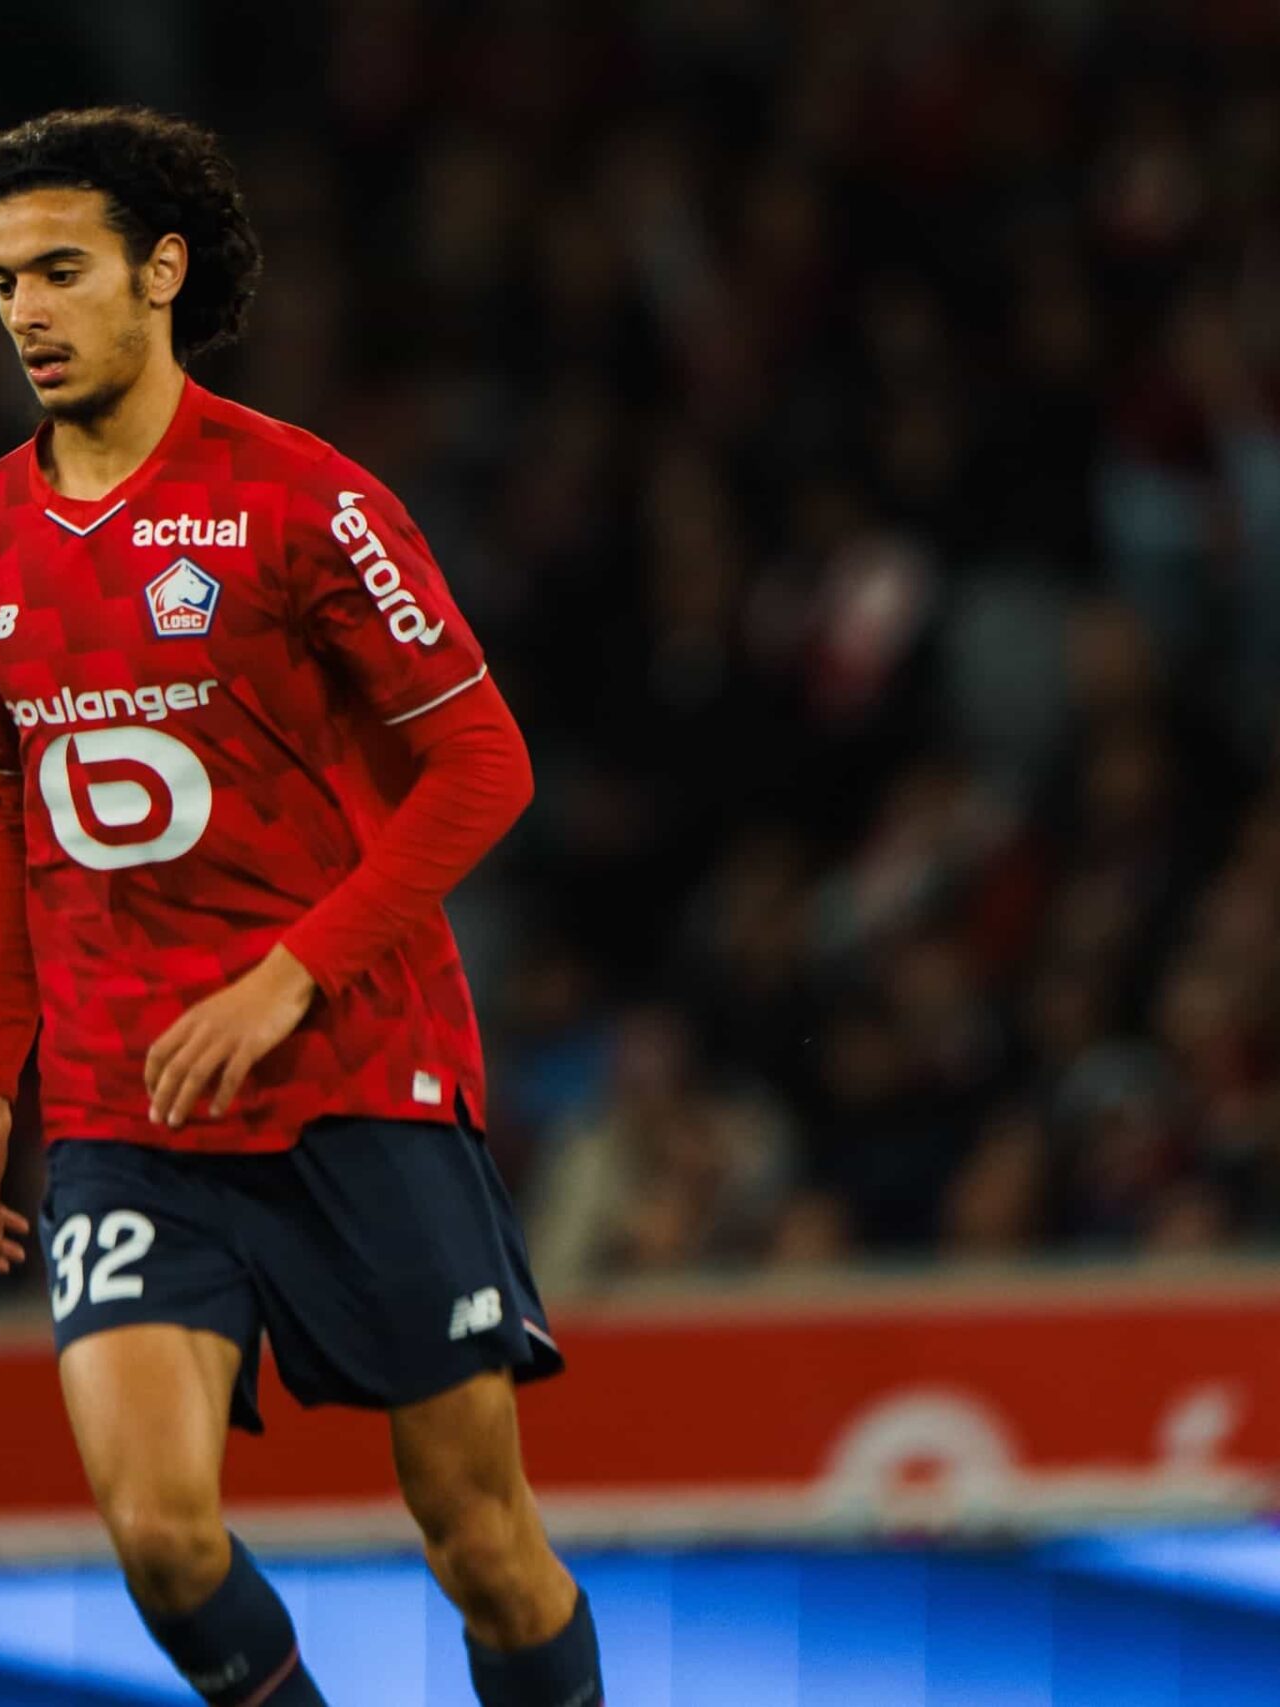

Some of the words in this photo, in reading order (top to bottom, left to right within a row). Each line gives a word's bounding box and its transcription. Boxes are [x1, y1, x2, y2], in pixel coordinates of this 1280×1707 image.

[132, 511, 248, 547] actual
[163, 614, 203, 629] LOSC
[51, 1210, 155, 1322] 32
